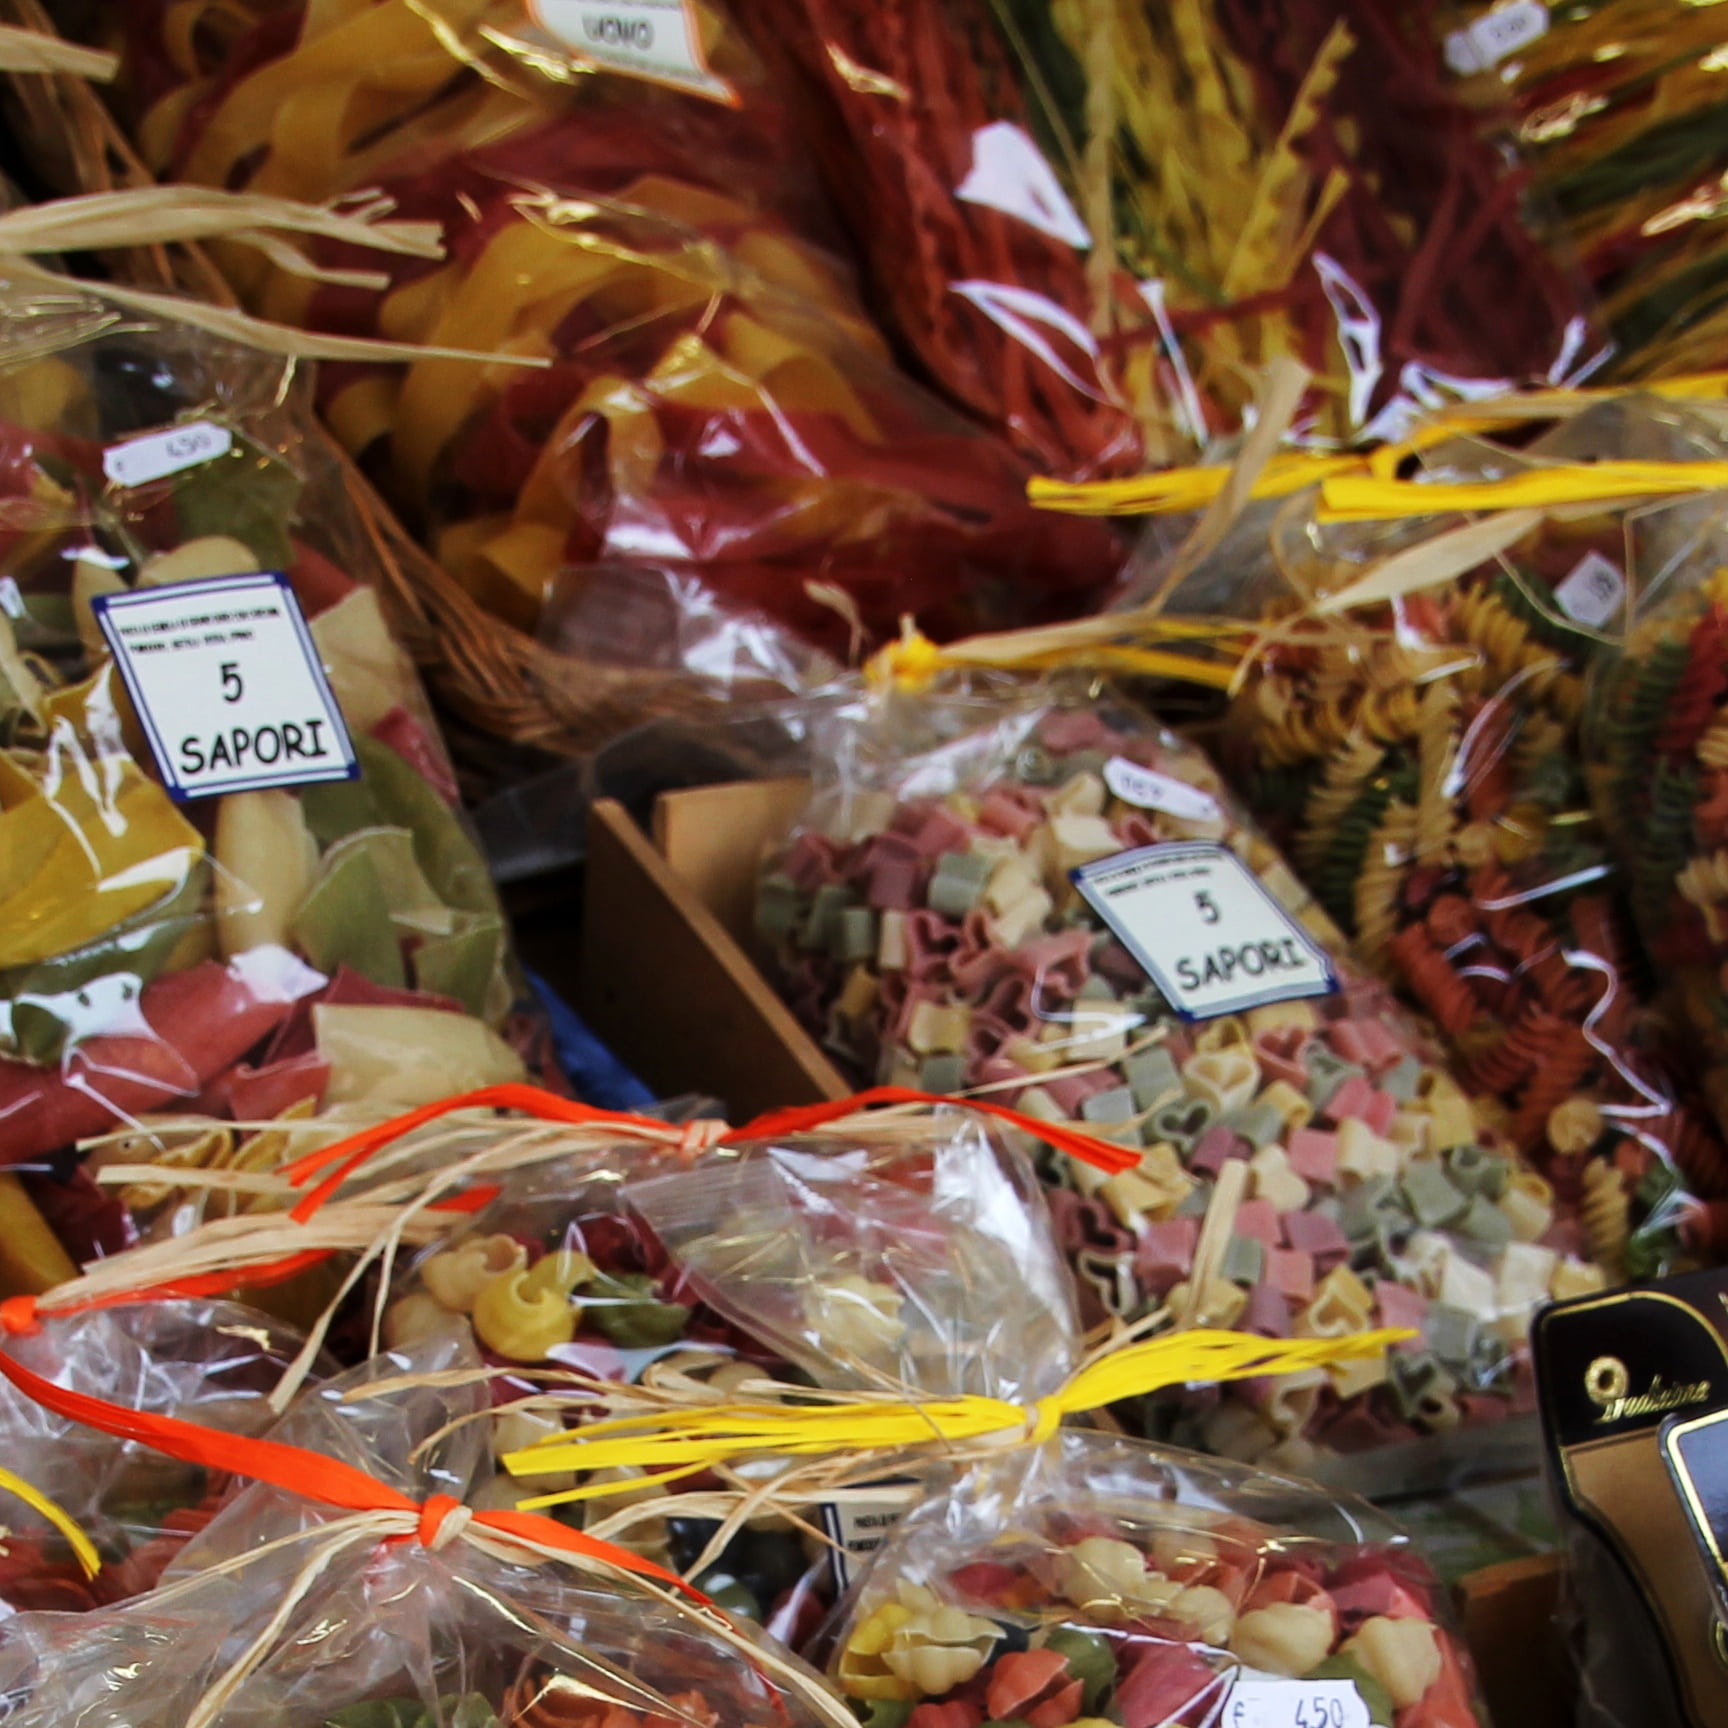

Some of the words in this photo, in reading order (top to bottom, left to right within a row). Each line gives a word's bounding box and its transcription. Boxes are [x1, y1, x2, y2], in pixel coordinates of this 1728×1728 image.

[220, 662, 245, 703] 5
[179, 719, 328, 775] SAPORI
[1193, 889, 1221, 925] 5
[1175, 937, 1307, 992] SAPORI
